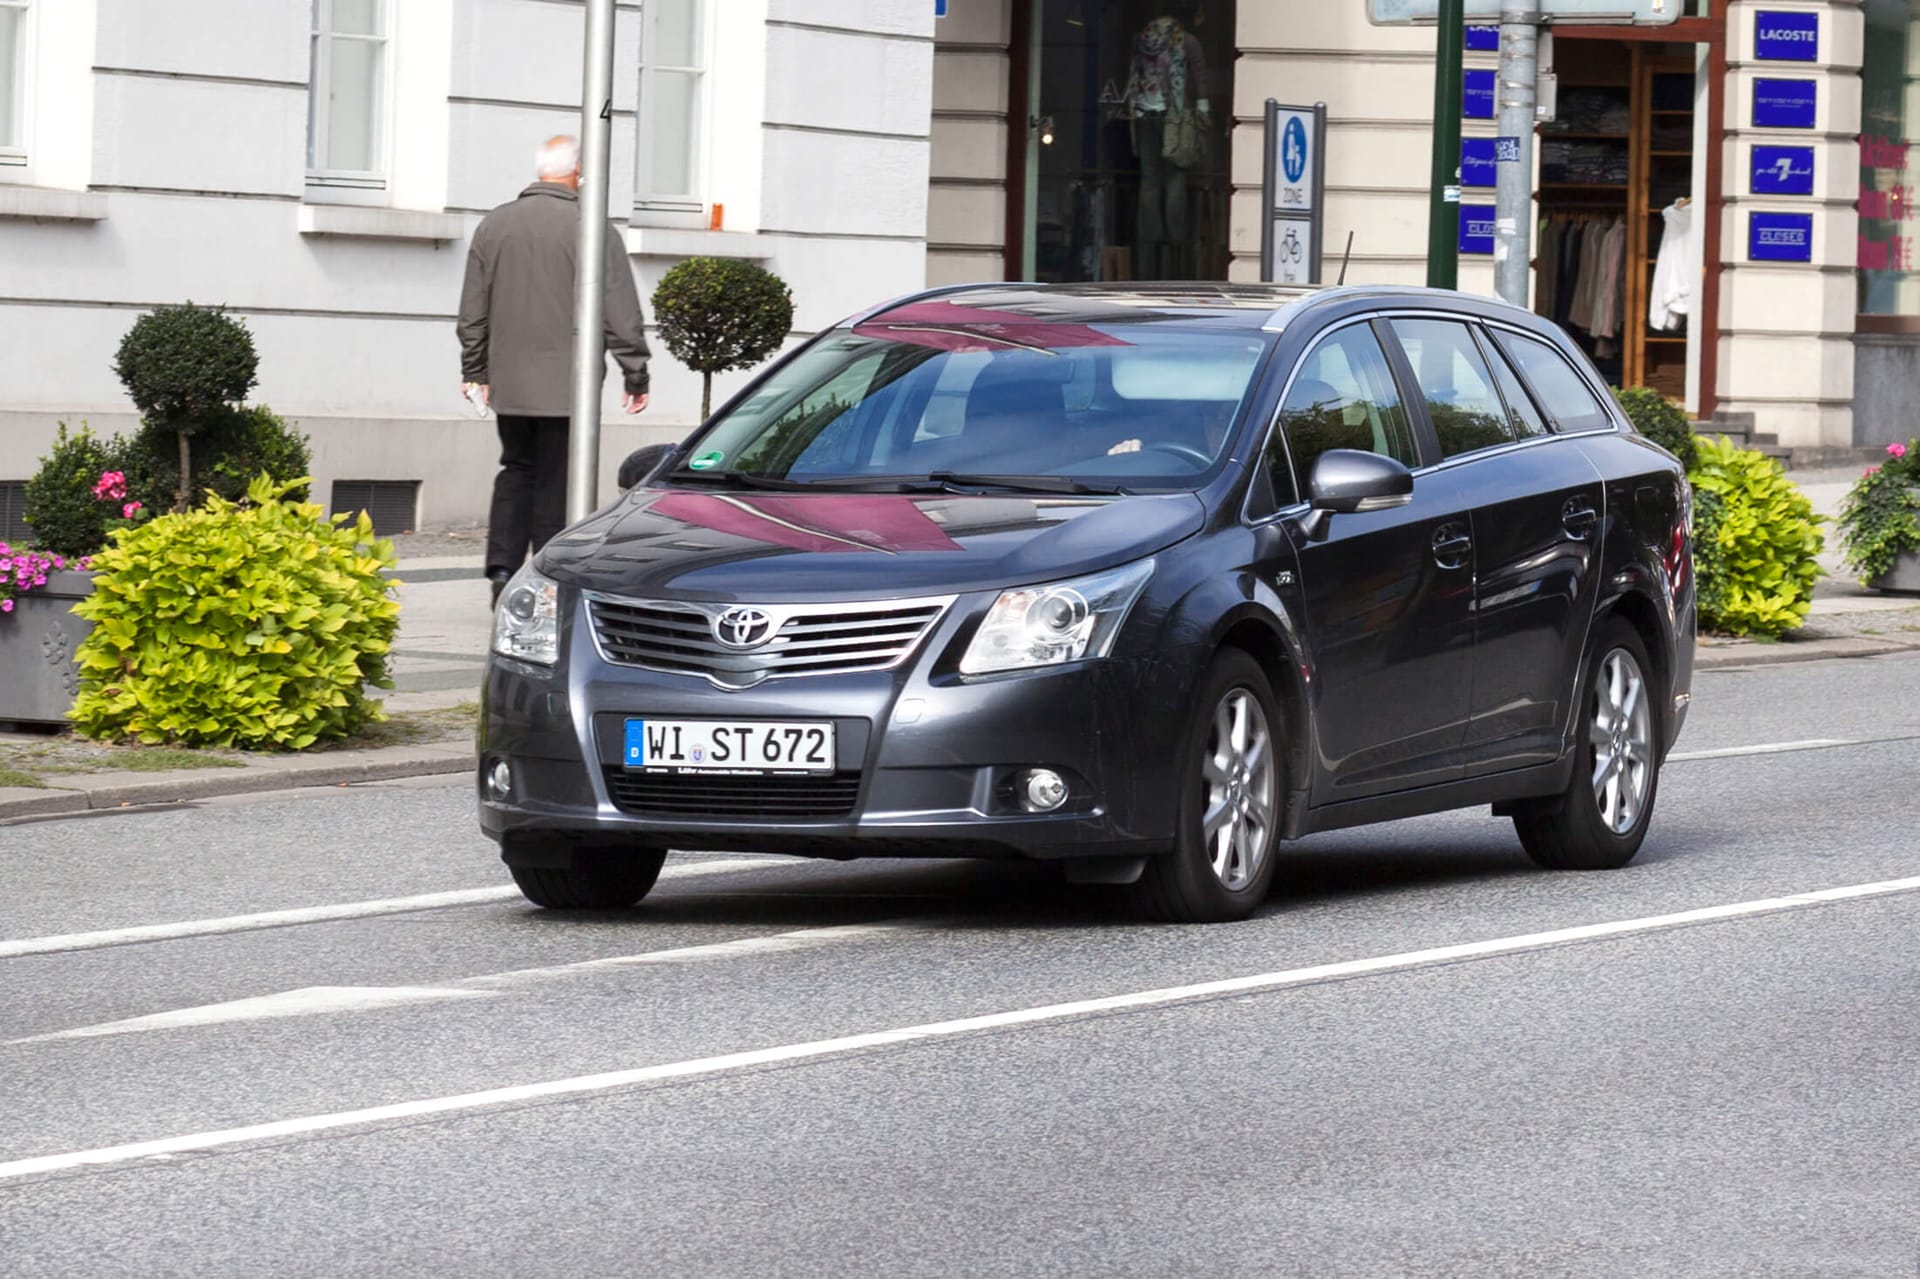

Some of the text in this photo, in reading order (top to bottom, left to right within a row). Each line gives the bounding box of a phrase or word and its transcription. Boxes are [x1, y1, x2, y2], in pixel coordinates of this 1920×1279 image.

[1760, 29, 1815, 42] LACOSTE
[1760, 231, 1804, 242] CLOSED
[648, 726, 825, 763] WI ST 672
